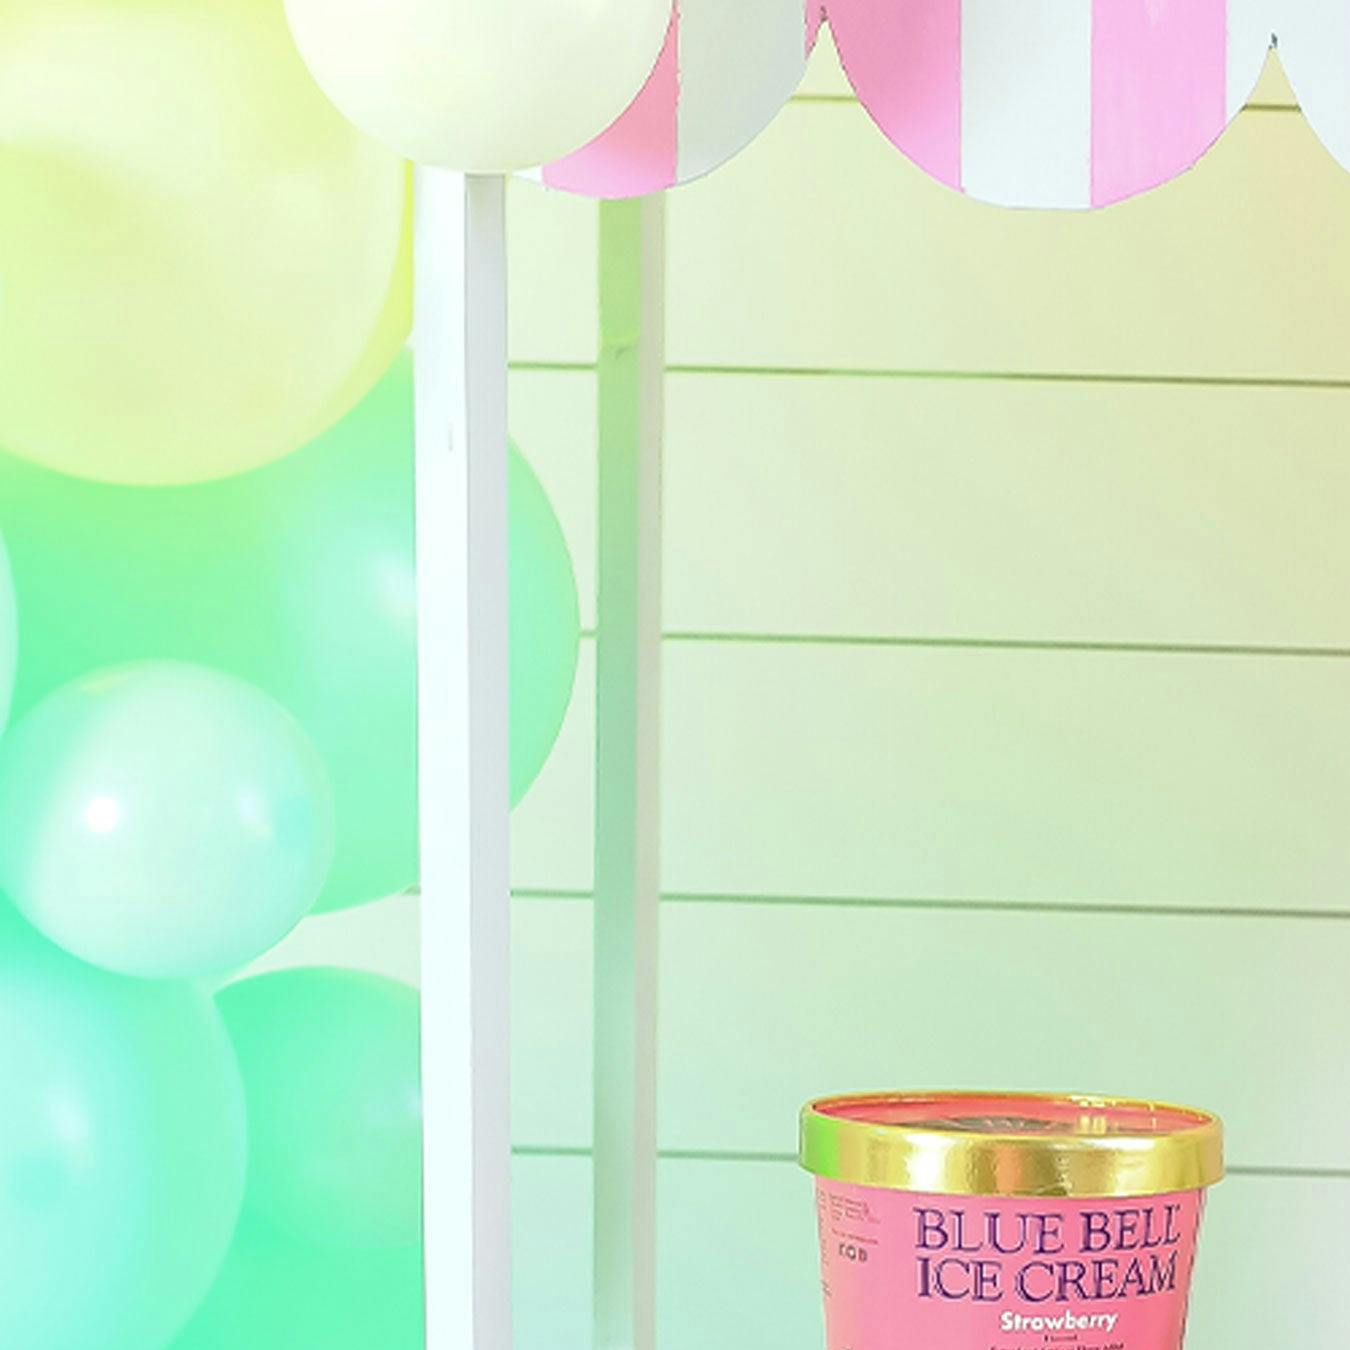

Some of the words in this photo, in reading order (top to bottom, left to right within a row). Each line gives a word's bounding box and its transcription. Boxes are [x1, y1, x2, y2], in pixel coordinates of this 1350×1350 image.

[913, 1206, 1065, 1255] BLUE
[1078, 1204, 1181, 1252] BELL
[917, 1256, 1003, 1301] ICE
[1015, 1250, 1178, 1302] CREAM
[1000, 1310, 1118, 1333] Strawberry
